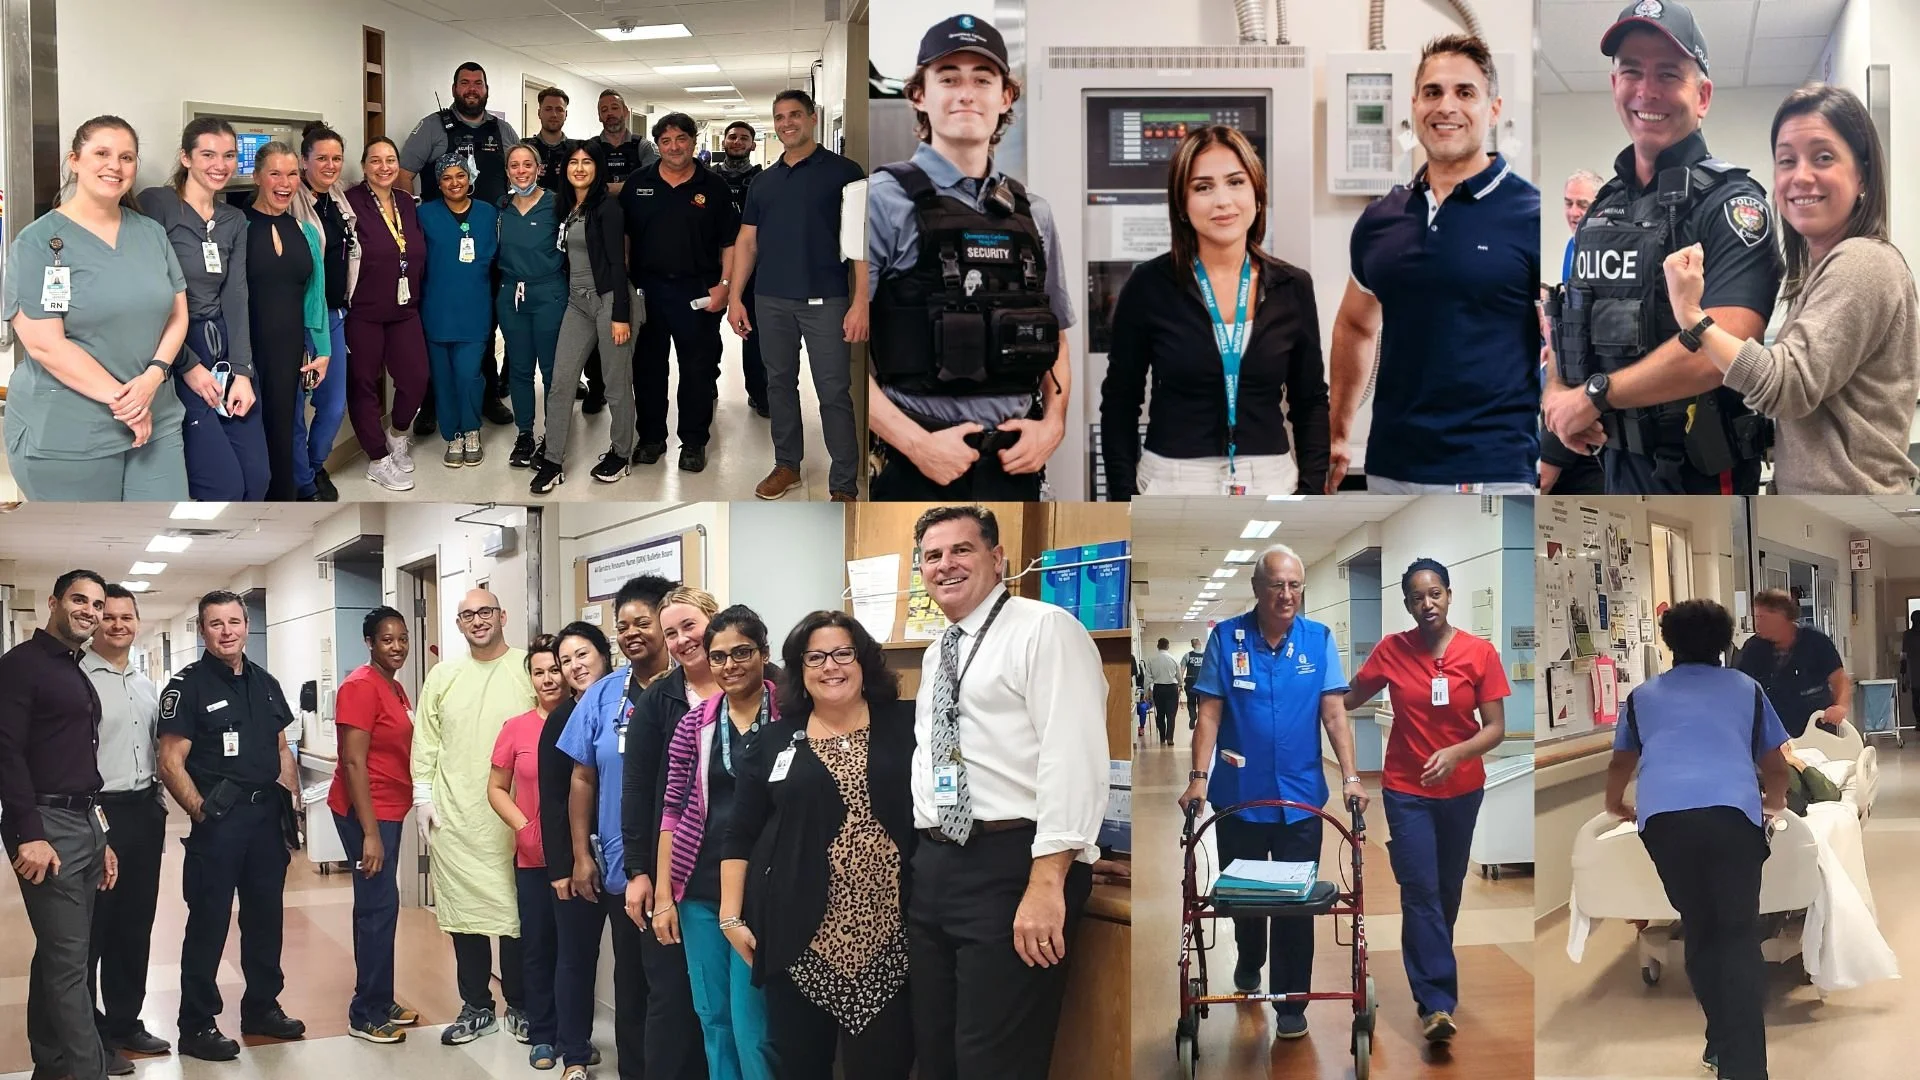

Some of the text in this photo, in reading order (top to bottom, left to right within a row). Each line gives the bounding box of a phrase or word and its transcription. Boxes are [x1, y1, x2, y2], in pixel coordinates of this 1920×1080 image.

[966, 246, 1010, 259] SECURITY
[1576, 249, 1639, 280] OLICE
[1239, 278, 1249, 308] STRONG
